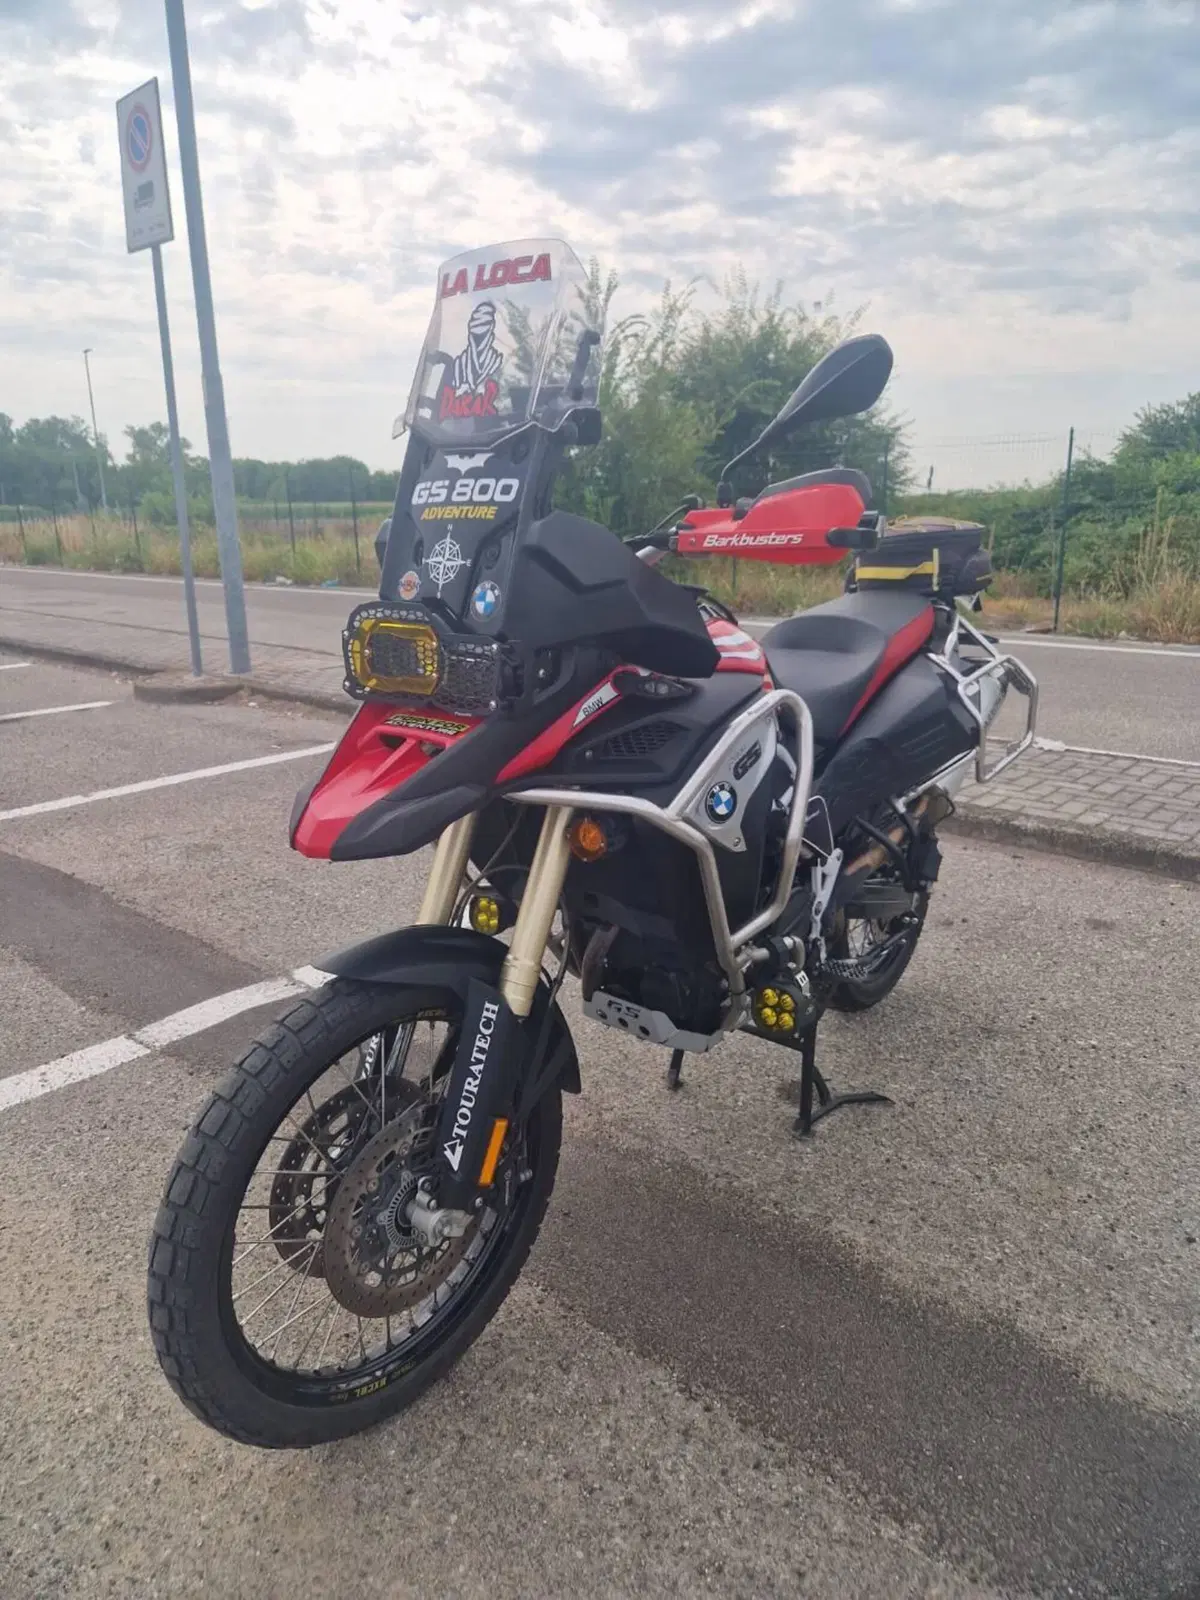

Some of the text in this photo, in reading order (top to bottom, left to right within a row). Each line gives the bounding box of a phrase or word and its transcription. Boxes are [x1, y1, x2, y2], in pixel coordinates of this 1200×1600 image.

[441, 253, 552, 299] LA LOCA
[411, 478, 520, 505] GS 800
[420, 505, 499, 521] ADVENTURE
[702, 531, 804, 549] Barkbusters
[582, 696, 604, 717] BMW
[384, 720, 459, 736] ADVENTURE
[452, 1000, 500, 1139] TOURATECH
